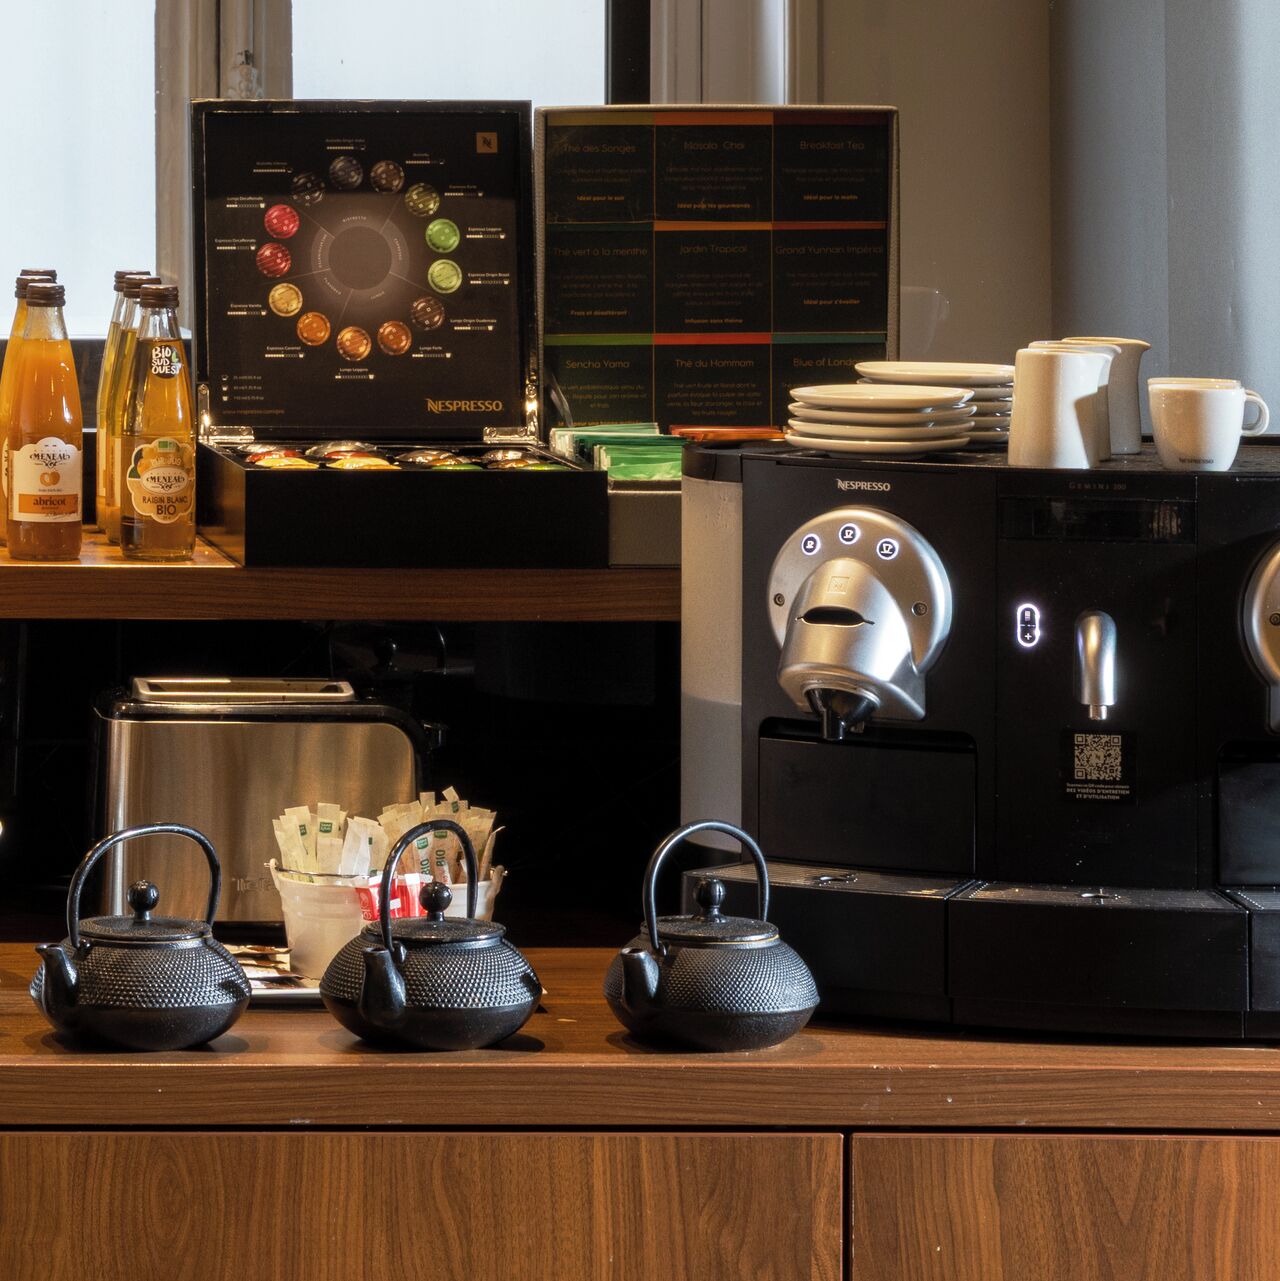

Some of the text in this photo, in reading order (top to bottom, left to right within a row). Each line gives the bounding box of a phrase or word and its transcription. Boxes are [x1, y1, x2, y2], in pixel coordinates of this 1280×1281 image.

[800, 140, 865, 150] Breakfast Tea
[612, 247, 648, 257] menthe
[775, 245, 806, 255] Grand
[808, 245, 844, 255] Yunnan
[152, 358, 170, 366] SUD
[566, 359, 630, 369] Sencha Yama
[675, 359, 754, 368] Thé du Hammam
[793, 358, 814, 367] Blue
[815, 358, 825, 367] of
[424, 398, 503, 414] NESPRESSO
[836, 478, 891, 491] NESPRESSO
[33, 496, 66, 506] abricot
[142, 495, 188, 504] RAISIN BLANC
[156, 504, 177, 516] BIO
[436, 849, 445, 867] BIO
